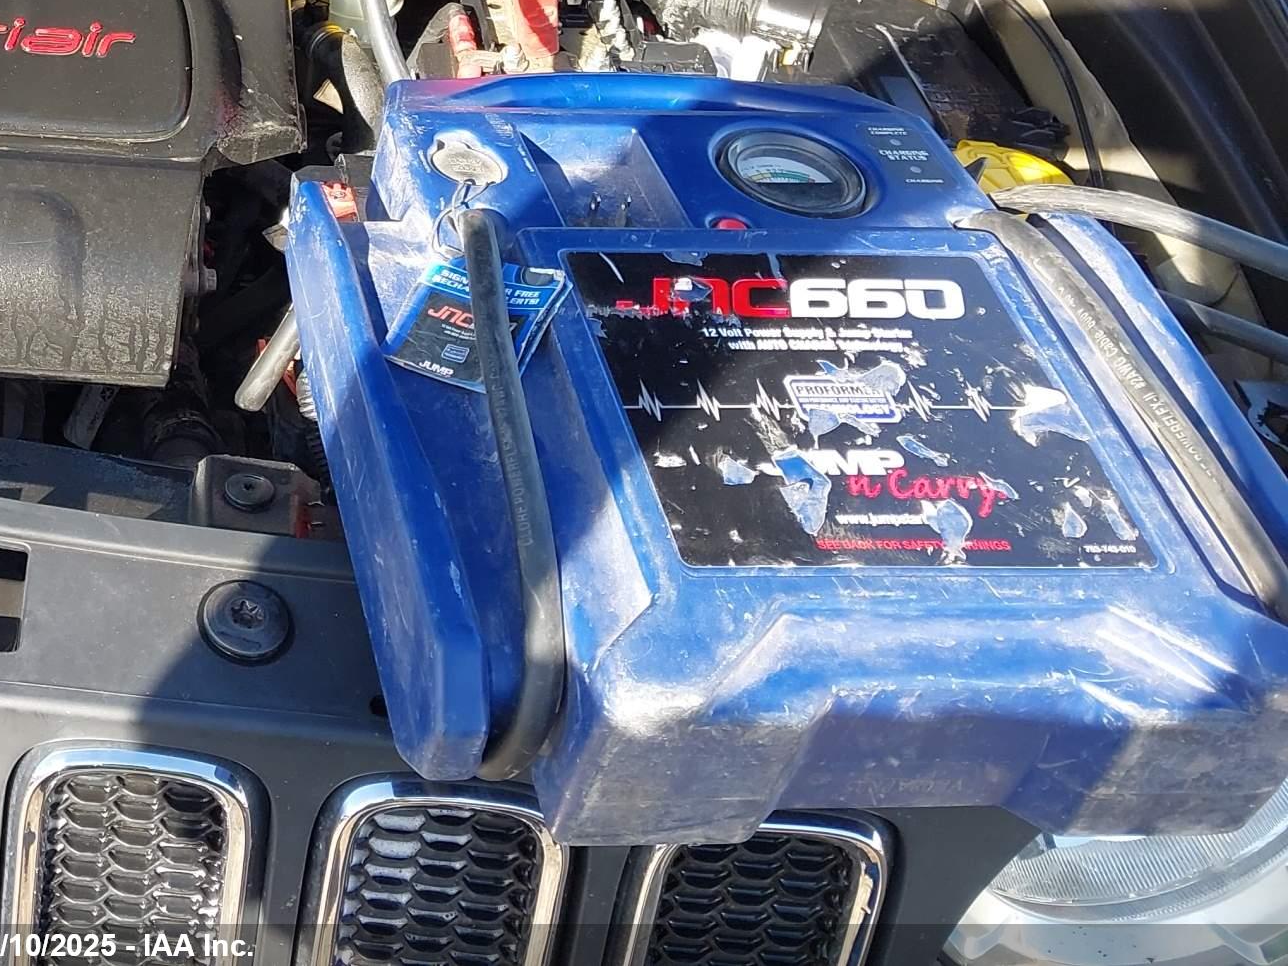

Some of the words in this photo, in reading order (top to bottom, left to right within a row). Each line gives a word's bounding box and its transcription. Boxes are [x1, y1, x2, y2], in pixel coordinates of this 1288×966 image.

[513, 289, 542, 298] FREE
[702, 327, 717, 337] 12
[718, 327, 743, 338] Volt
[745, 327, 782, 338] Power
[728, 339, 757, 351] with
[757, 339, 788, 351] AUTO
[419, 360, 454, 375] JUMP
[848, 474, 882, 498] n
[816, 538, 842, 551] SEE
[875, 538, 902, 551] FOR
[903, 538, 944, 551] SAFETY
